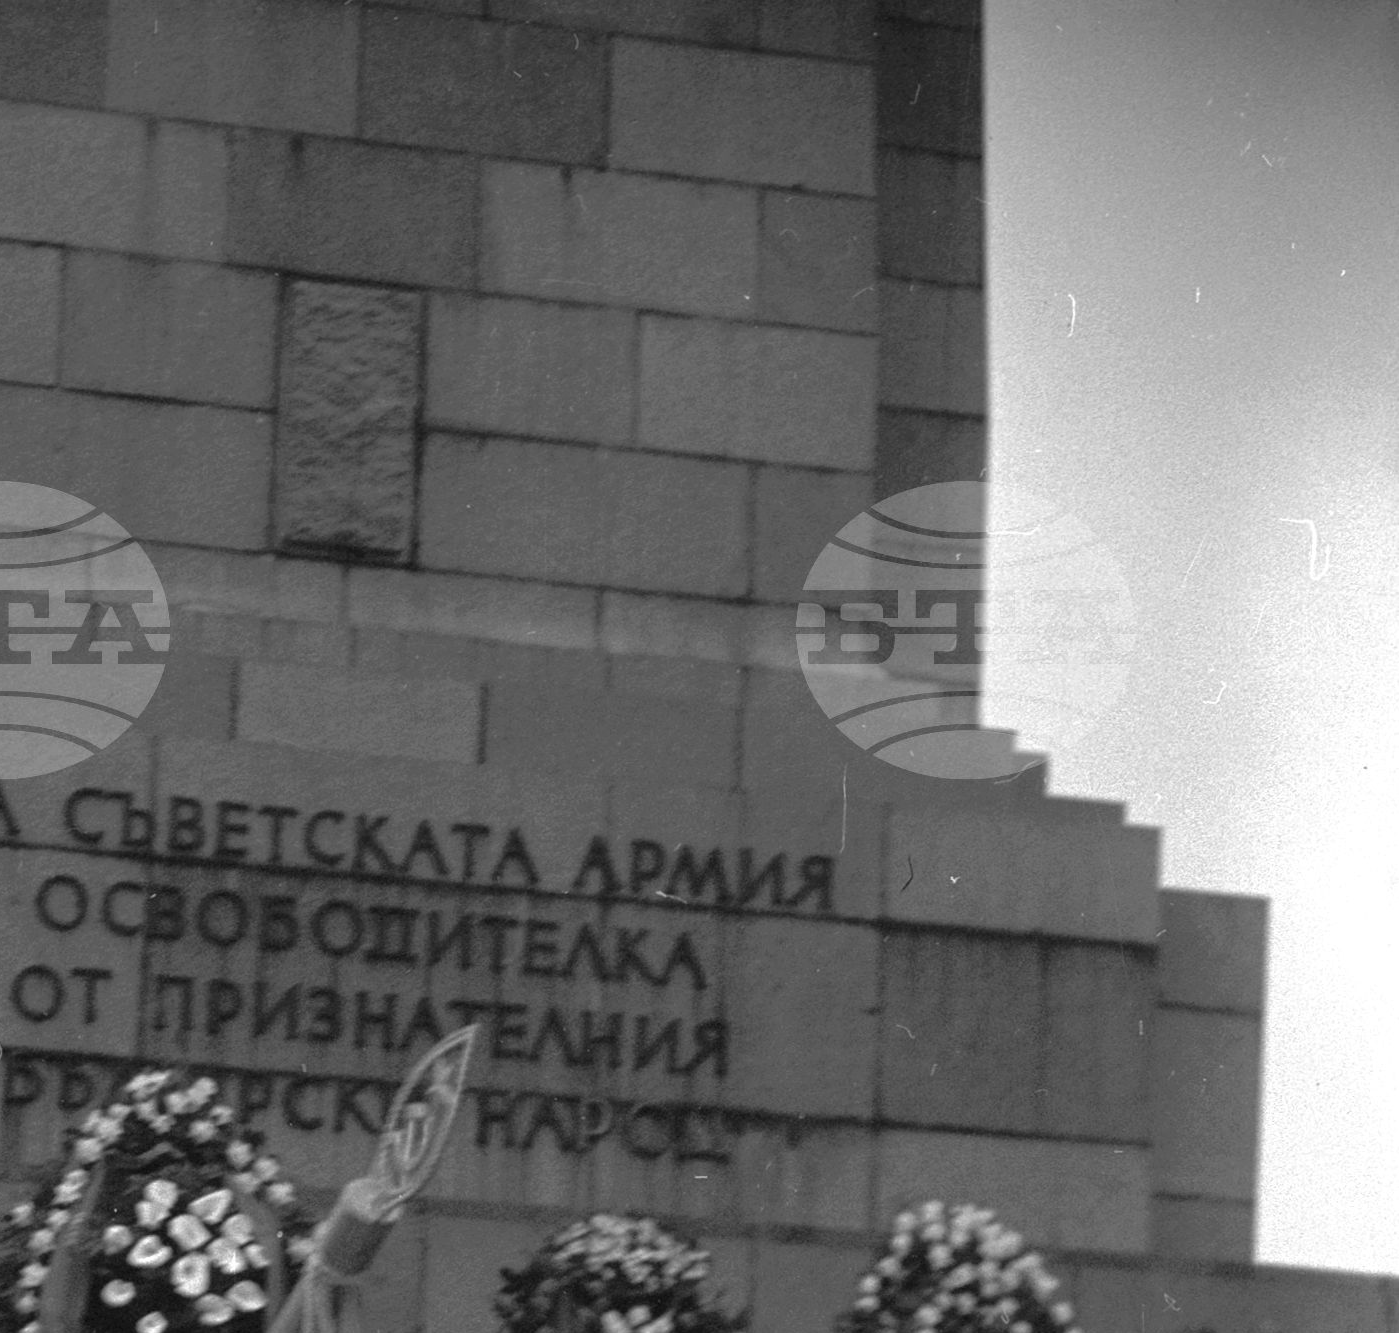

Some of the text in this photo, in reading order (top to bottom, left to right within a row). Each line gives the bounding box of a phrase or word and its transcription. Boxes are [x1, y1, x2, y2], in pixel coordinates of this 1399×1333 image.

[62, 787, 541, 891] СЪВЕТСКАТА
[571, 836, 837, 912] АРМИЯ
[32, 874, 710, 992] ОСВОБОДИТЕЛКА
[9, 961, 732, 1080] ОТ ПРИЗНАТЕЛНИЯ
